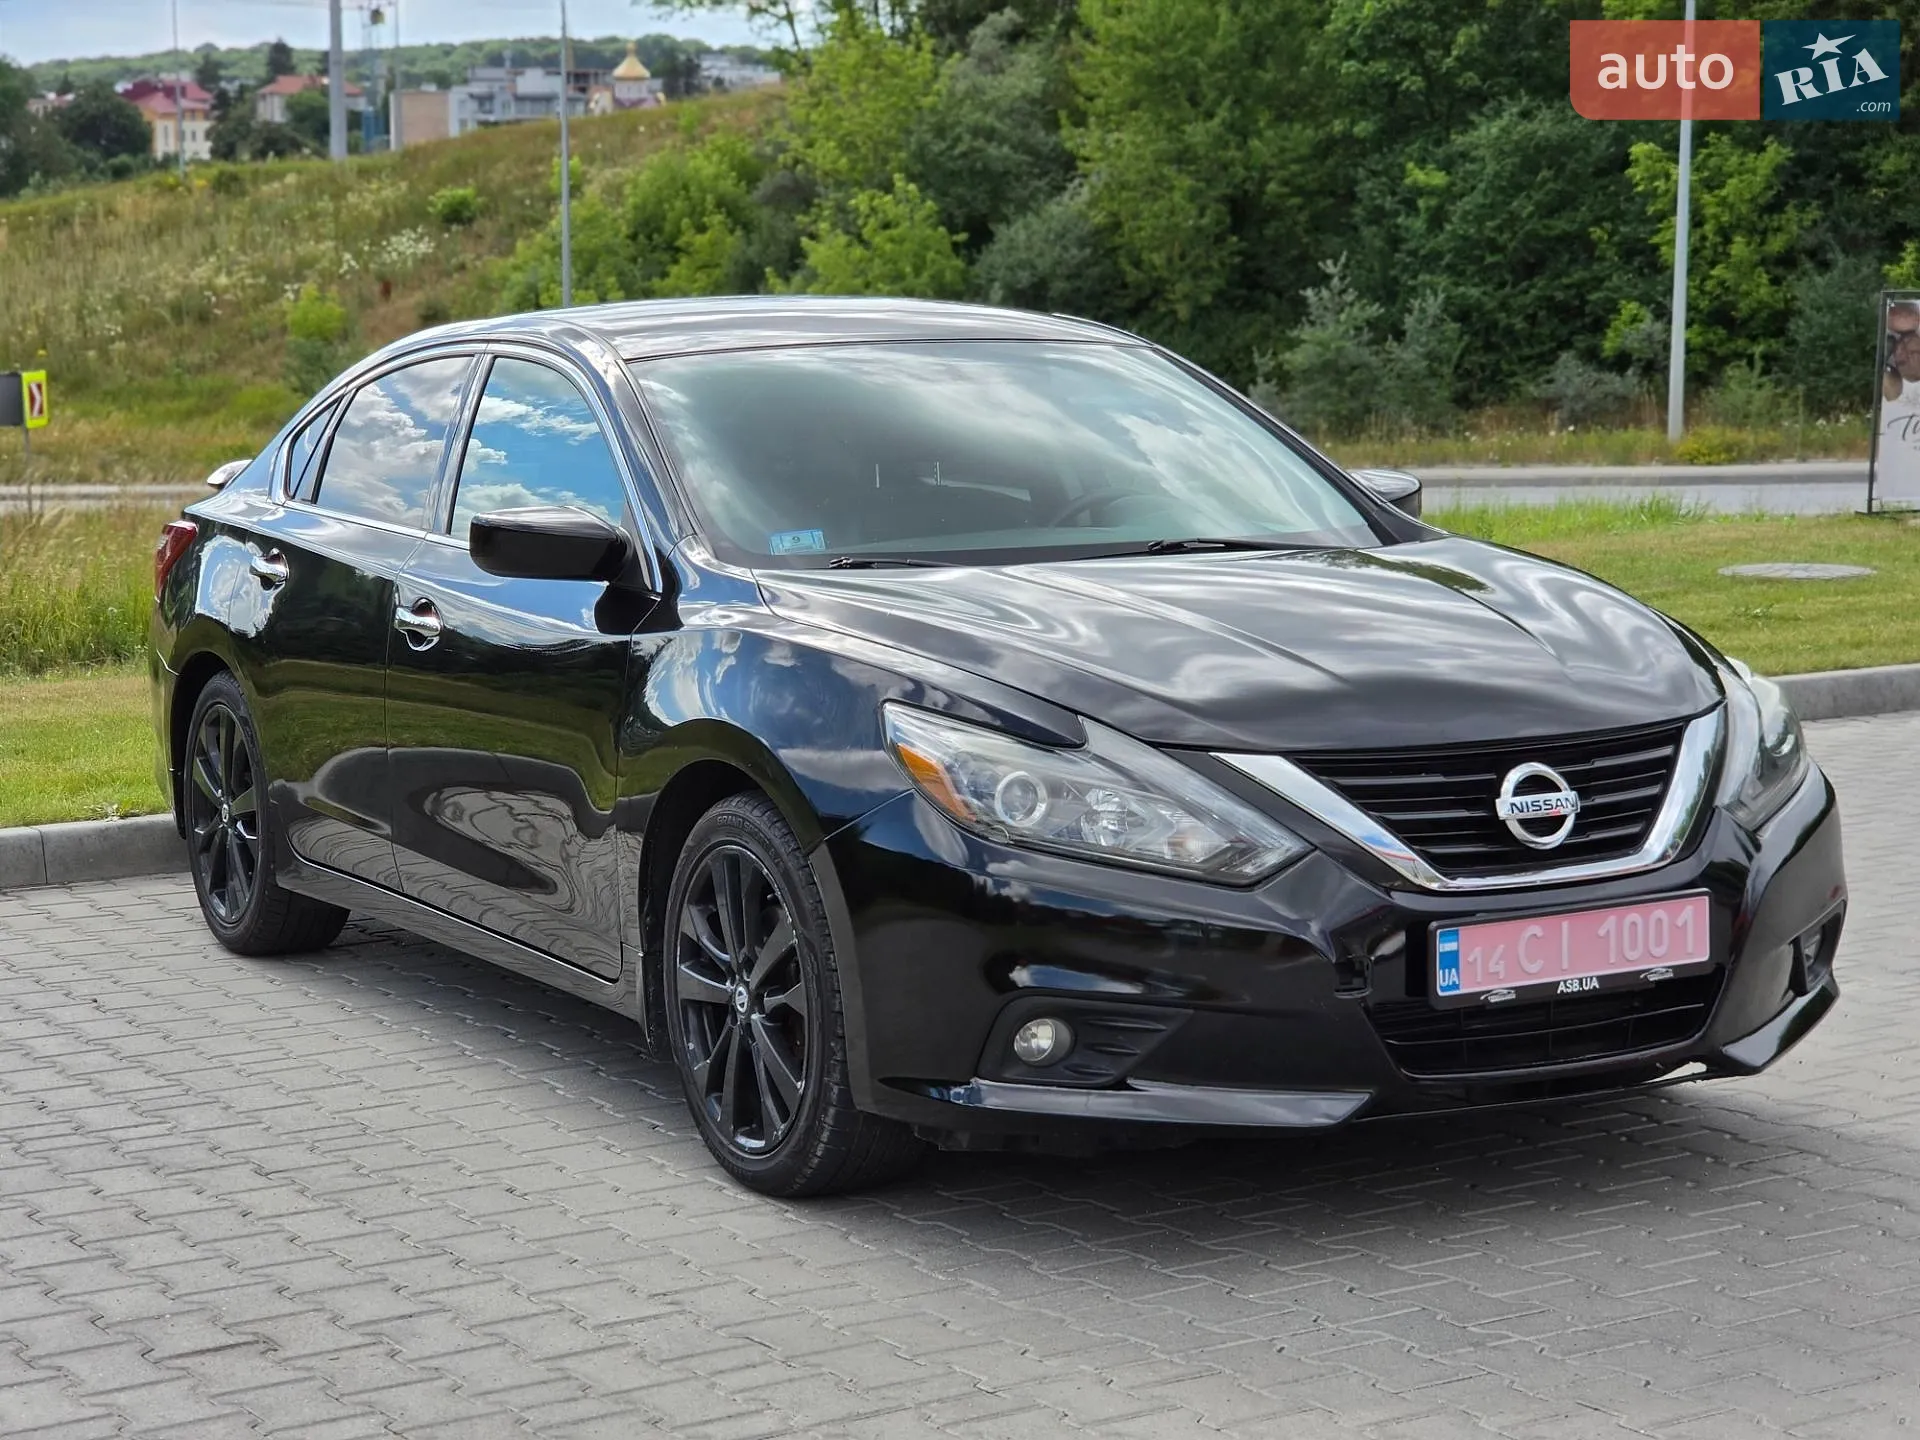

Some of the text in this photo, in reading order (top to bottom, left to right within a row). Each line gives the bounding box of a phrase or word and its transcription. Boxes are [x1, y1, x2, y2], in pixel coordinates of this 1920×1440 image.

[1510, 797, 1576, 814] NISSAN
[1467, 944, 1505, 983] 14
[1597, 904, 1696, 965] 1001
[1439, 967, 1459, 987] UA
[1556, 976, 1600, 994] ASB.UA
